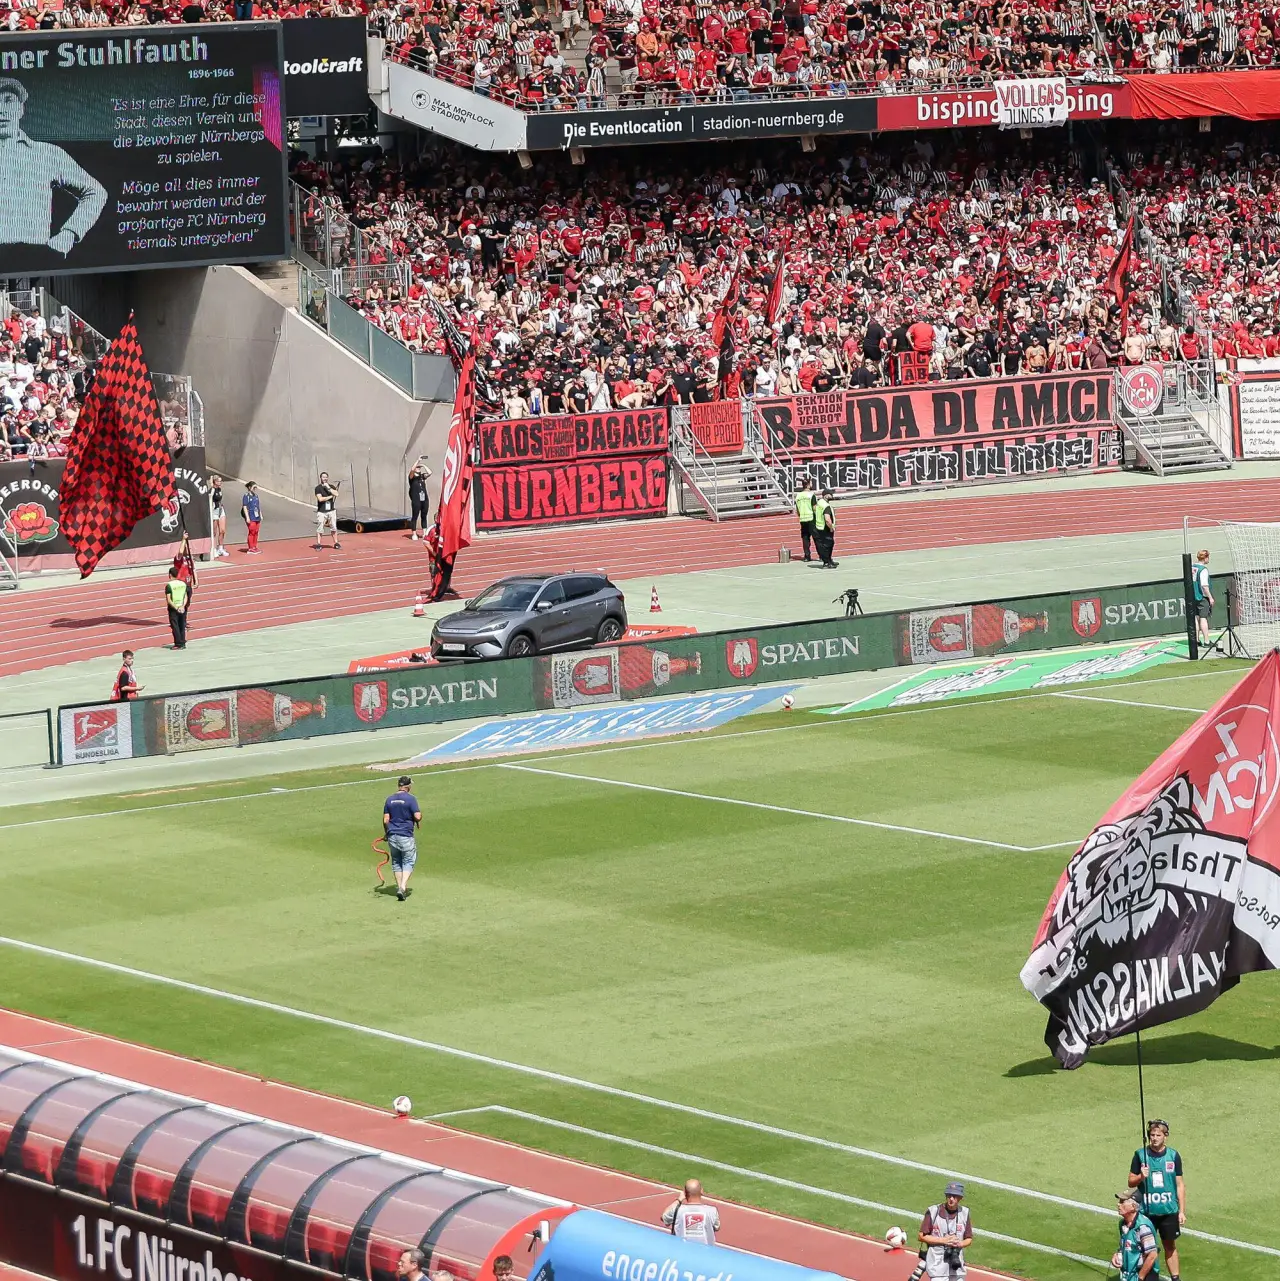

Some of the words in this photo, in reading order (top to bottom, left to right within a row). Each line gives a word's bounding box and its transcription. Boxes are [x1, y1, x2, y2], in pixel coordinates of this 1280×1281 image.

[58, 36, 208, 68] Stuhlfauth
[283, 56, 363, 75] toolcraft
[131, 97, 146, 110] ist
[149, 96, 175, 110] eine
[178, 94, 210, 109] Ehre,
[211, 93, 232, 109] für
[234, 92, 266, 105] diese
[1001, 83, 1065, 109] VOLLGAS
[151, 115, 192, 128] diesen
[196, 111, 235, 125] Verein
[238, 109, 262, 123] und
[431, 104, 467, 124] STADION
[433, 98, 452, 110] MAX
[453, 106, 495, 128] MORLOCK
[917, 94, 1000, 125] bisping
[1004, 106, 1045, 125] JUNGS
[564, 123, 586, 139] Die
[590, 119, 682, 137] Eventlocation
[703, 110, 844, 132] stadion-nuernberg.de
[113, 134, 133, 149] die
[135, 132, 197, 147] Bewohner
[200, 129, 265, 143] Nürnbergs
[157, 153, 172, 165] zu
[122, 180, 160, 196] Möge
[165, 178, 181, 192] all
[185, 177, 213, 191] dies
[217, 176, 261, 189] immer
[116, 198, 168, 213] bewahrt
[171, 195, 216, 210] werden
[220, 193, 243, 207] und
[246, 193, 267, 206] der
[118, 216, 184, 234] großartige
[187, 214, 204, 228] FC
[206, 211, 267, 227] Nürnberg
[128, 234, 177, 250] niemals
[1139, 376, 1148, 388] 1.
[795, 395, 843, 406] SEKTION
[1131, 387, 1154, 402] FCN
[797, 404, 843, 415] STADION
[933, 388, 979, 433] DI
[992, 380, 1113, 429] AMICI
[800, 414, 843, 426] VERBOT
[482, 423, 542, 460] KAOS
[575, 413, 665, 452] BAGAGE
[894, 448, 960, 485] FÜR
[965, 436, 1094, 479] ULTRAS!
[761, 635, 860, 667] SPATEN
[559, 659, 567, 700] SPATEN
[391, 677, 499, 711] SPATEN
[173, 703, 182, 745] SPATEN
[75, 748, 120, 761] BUNDESLIGA
[1143, 1192, 1173, 1204] HOST
[72, 1214, 94, 1267] 1.
[98, 1218, 133, 1280] FC
[137, 1231, 252, 1281] Nürnb
